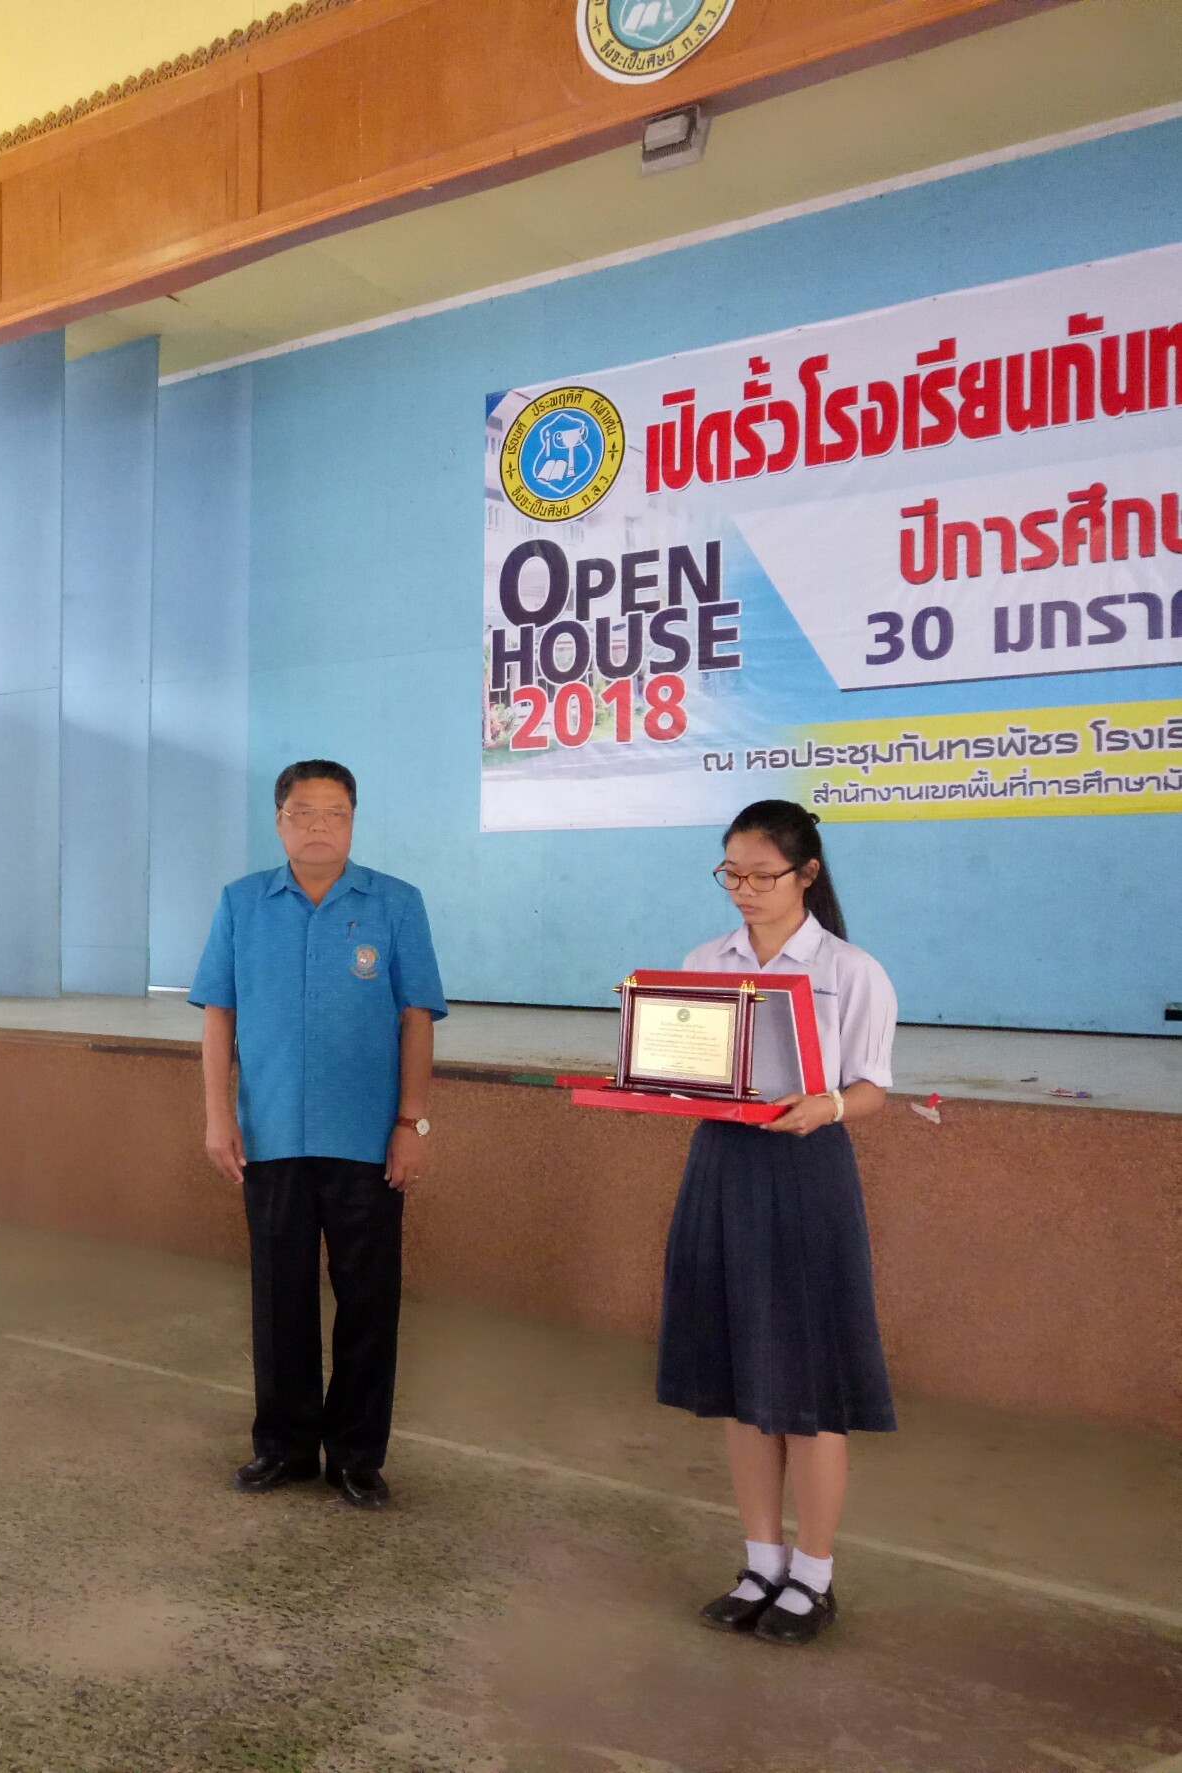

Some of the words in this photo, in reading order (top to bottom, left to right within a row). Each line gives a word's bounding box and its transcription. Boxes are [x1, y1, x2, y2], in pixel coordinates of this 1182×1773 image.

[499, 539, 721, 628] OPEN
[491, 602, 740, 690] HOUSE
[866, 605, 954, 665] 30
[994, 589, 1182, 654] มกรา
[510, 673, 688, 750] 2018
[702, 751, 734, 772] ณ
[746, 727, 1079, 774] หอประชุมกันทรพัชร
